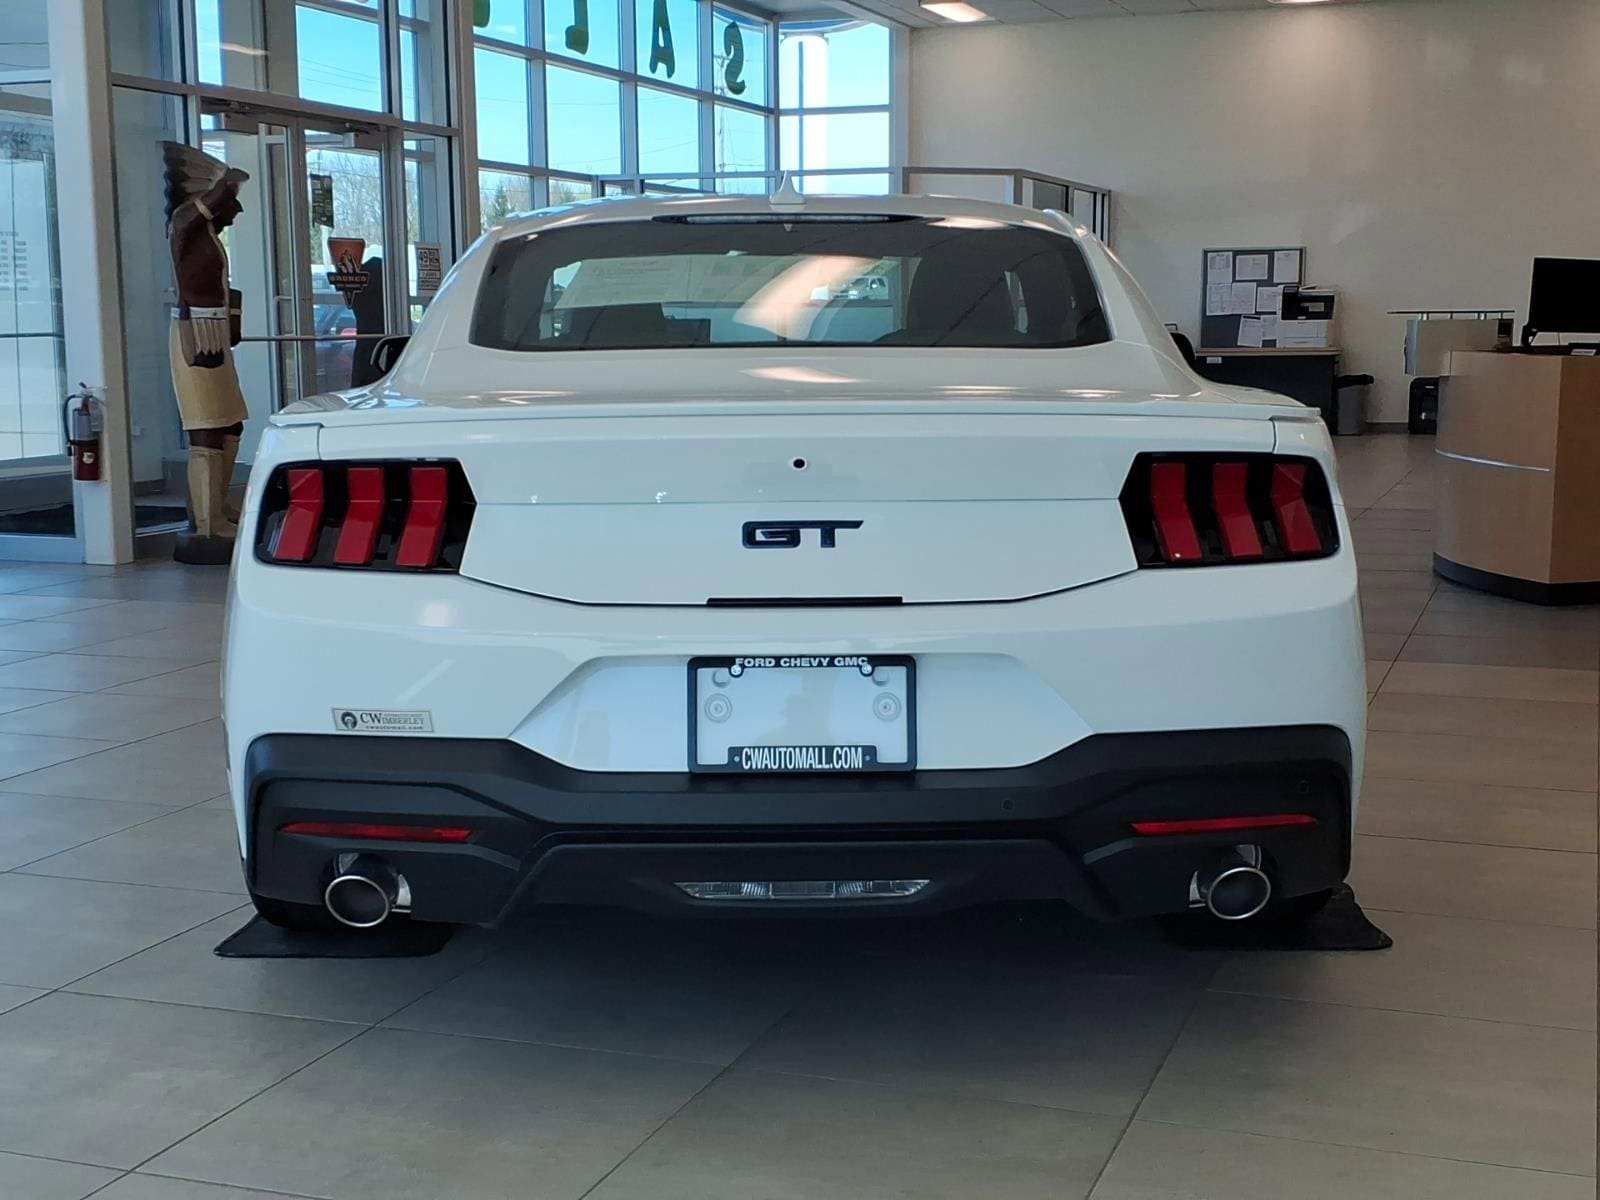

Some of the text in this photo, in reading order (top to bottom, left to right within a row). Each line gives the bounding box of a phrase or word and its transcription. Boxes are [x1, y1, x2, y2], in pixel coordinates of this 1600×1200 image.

[742, 520, 864, 549] GT
[735, 656, 868, 668] FORD CHEVY GMC
[742, 747, 862, 770] CWAUTOMALL.COM
